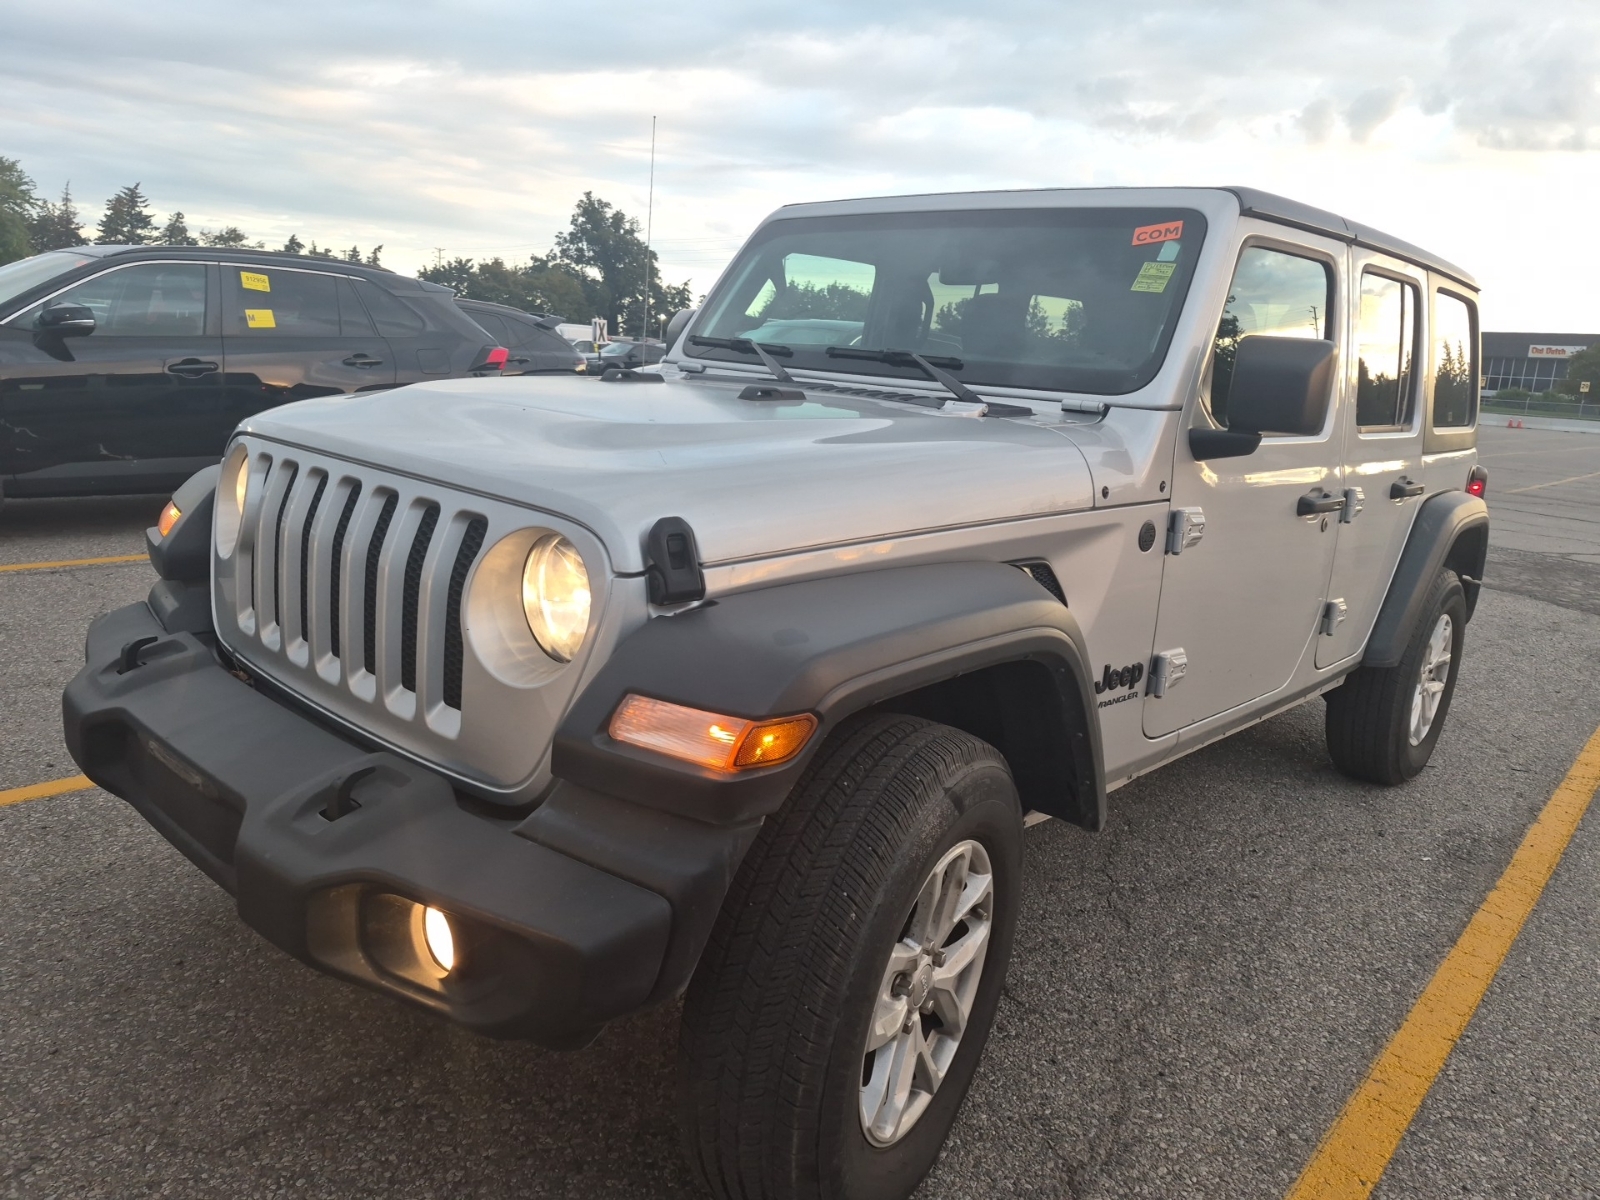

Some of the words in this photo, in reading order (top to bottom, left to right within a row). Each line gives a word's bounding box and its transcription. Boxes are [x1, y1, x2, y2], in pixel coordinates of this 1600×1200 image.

[1136, 226, 1180, 242] COM
[247, 314, 256, 322] M
[597, 322, 606, 342] X
[1094, 662, 1144, 695] Jeep
